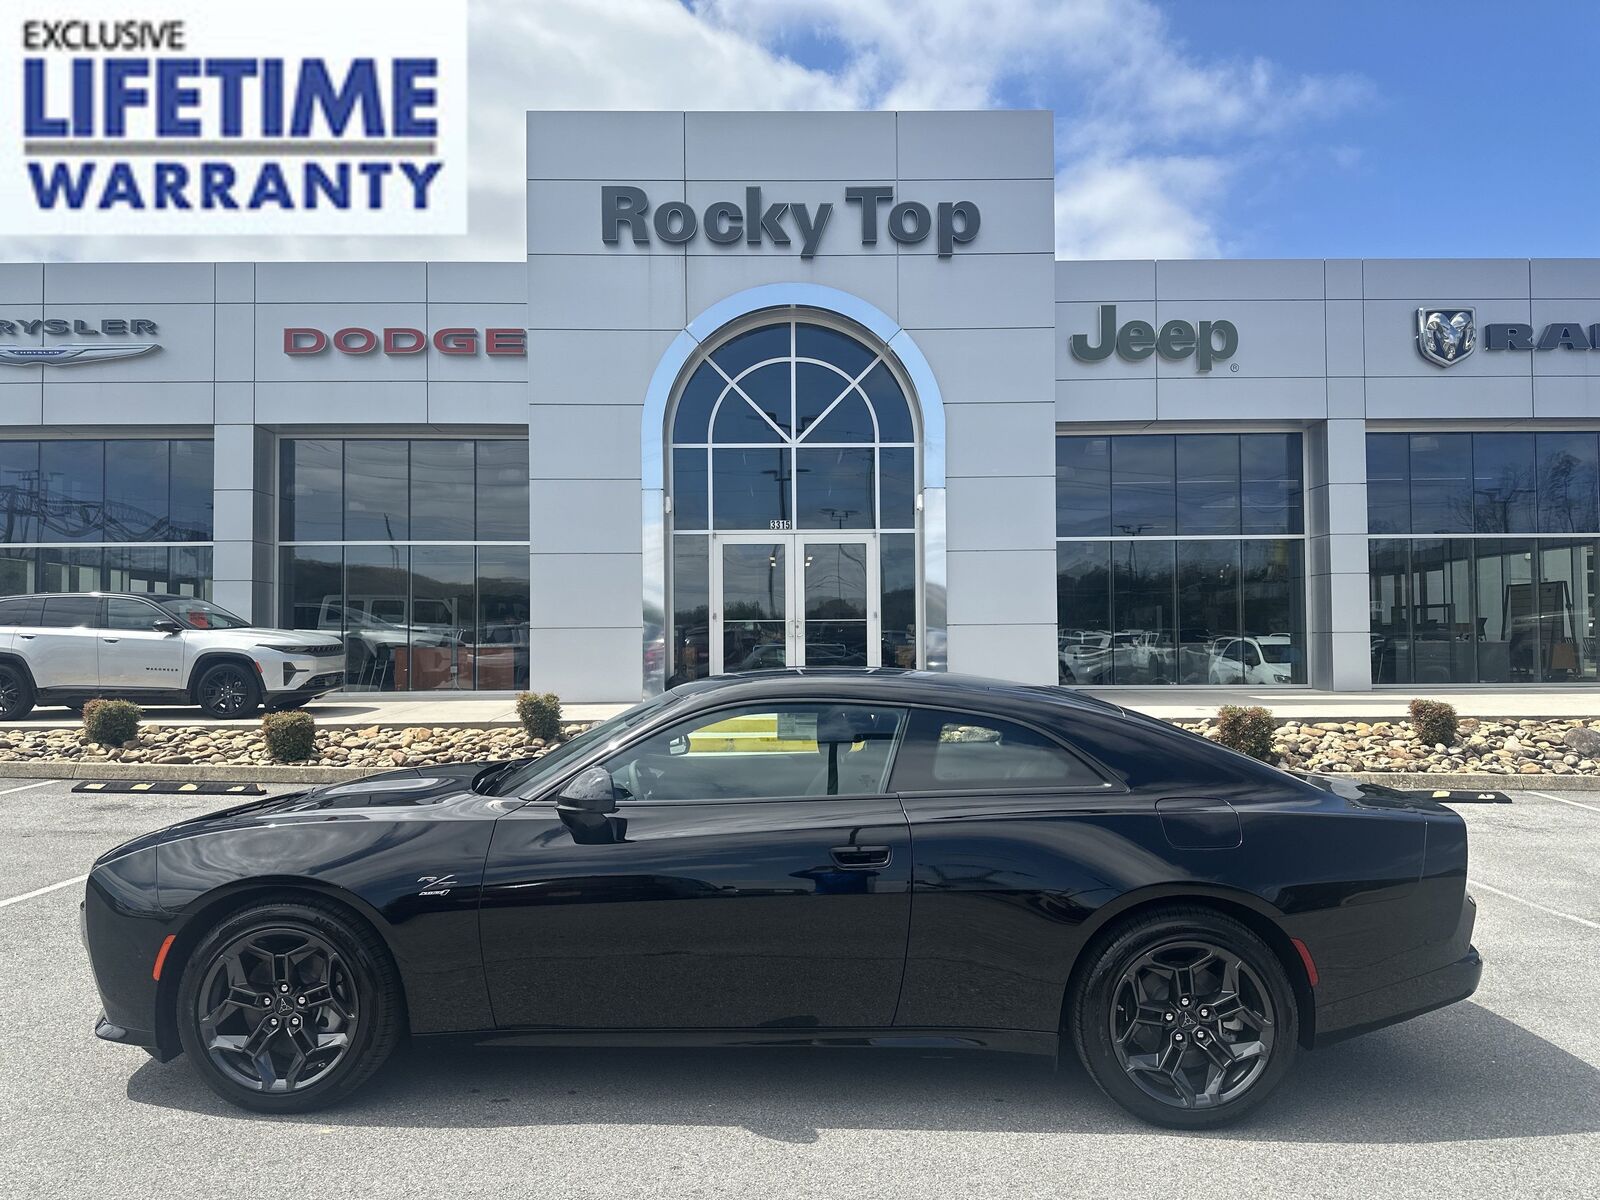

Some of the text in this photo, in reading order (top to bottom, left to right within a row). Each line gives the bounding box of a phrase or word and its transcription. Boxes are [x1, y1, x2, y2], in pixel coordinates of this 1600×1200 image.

[601, 186, 981, 258] Rocky Top
[284, 328, 527, 354] DODGE
[1070, 304, 1239, 373] Jeep
[1485, 323, 1600, 351] RA
[770, 520, 791, 530] 3315
